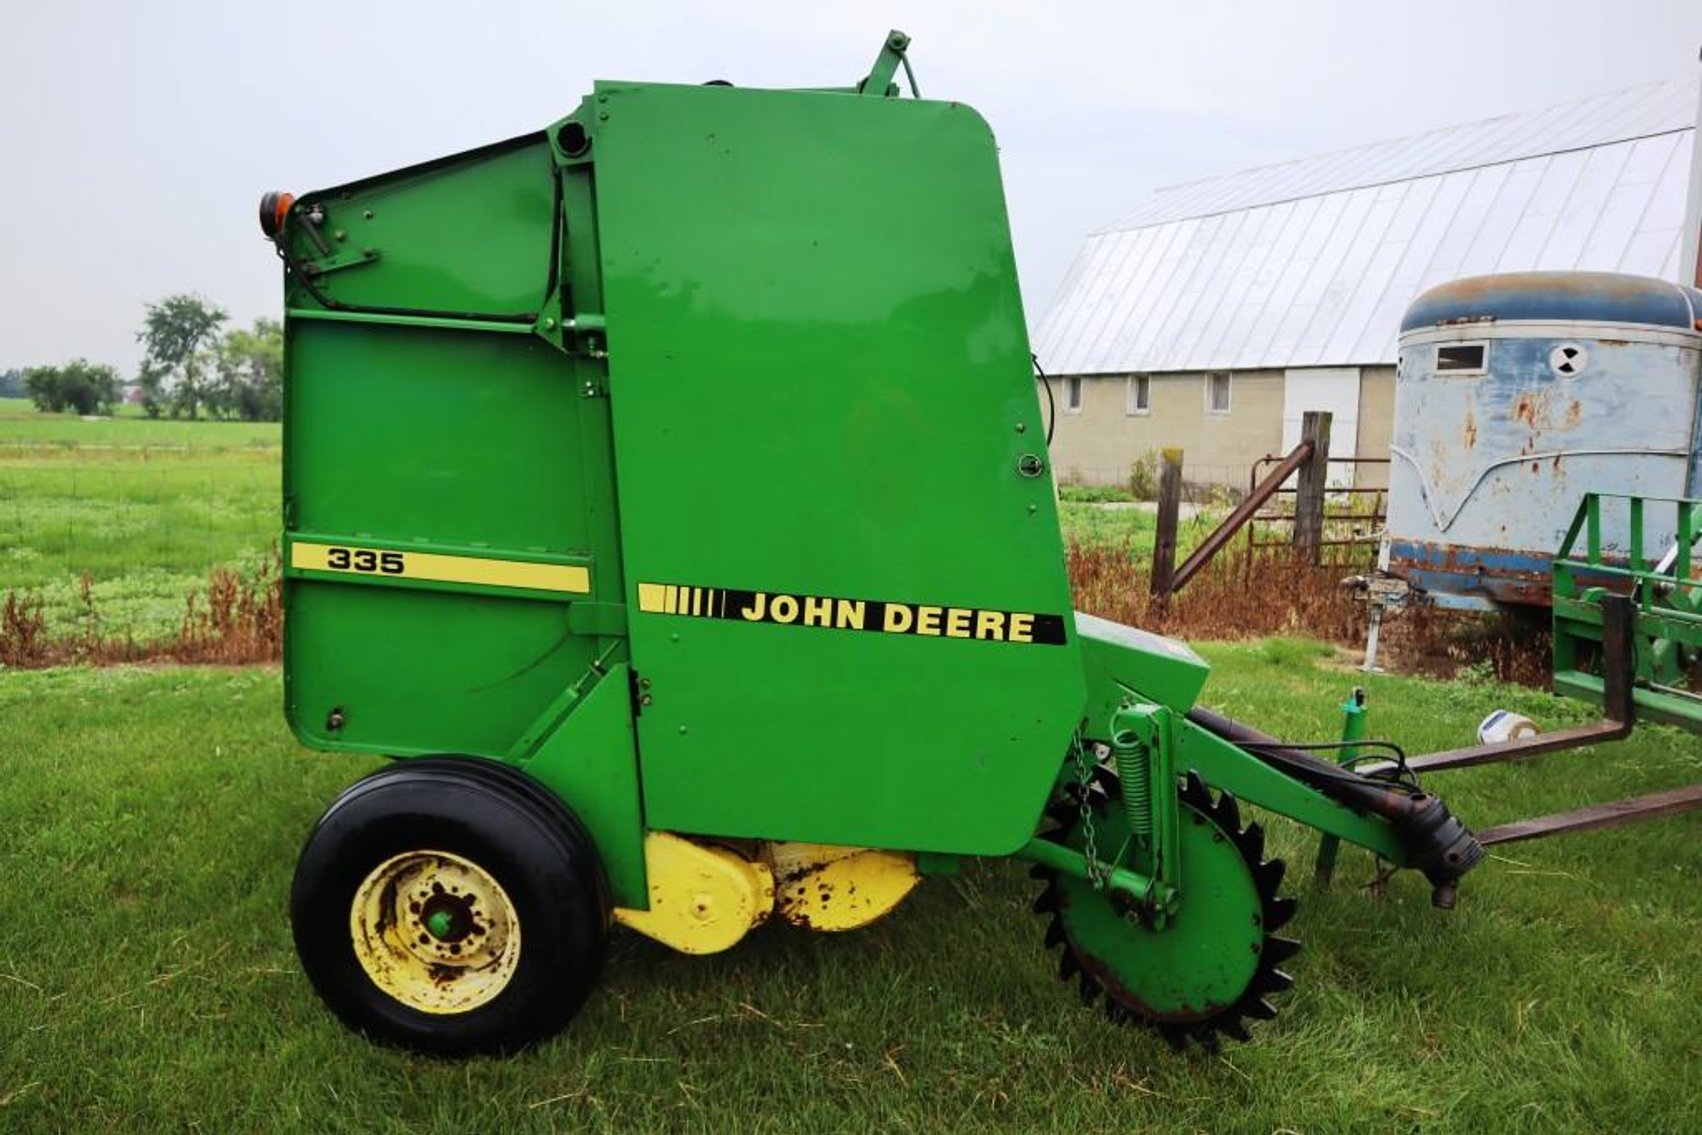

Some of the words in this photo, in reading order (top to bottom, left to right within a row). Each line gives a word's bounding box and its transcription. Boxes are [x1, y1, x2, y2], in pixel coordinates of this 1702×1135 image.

[328, 548, 405, 575] 335
[742, 593, 866, 630] JOHN
[883, 603, 1035, 643] DEERE
